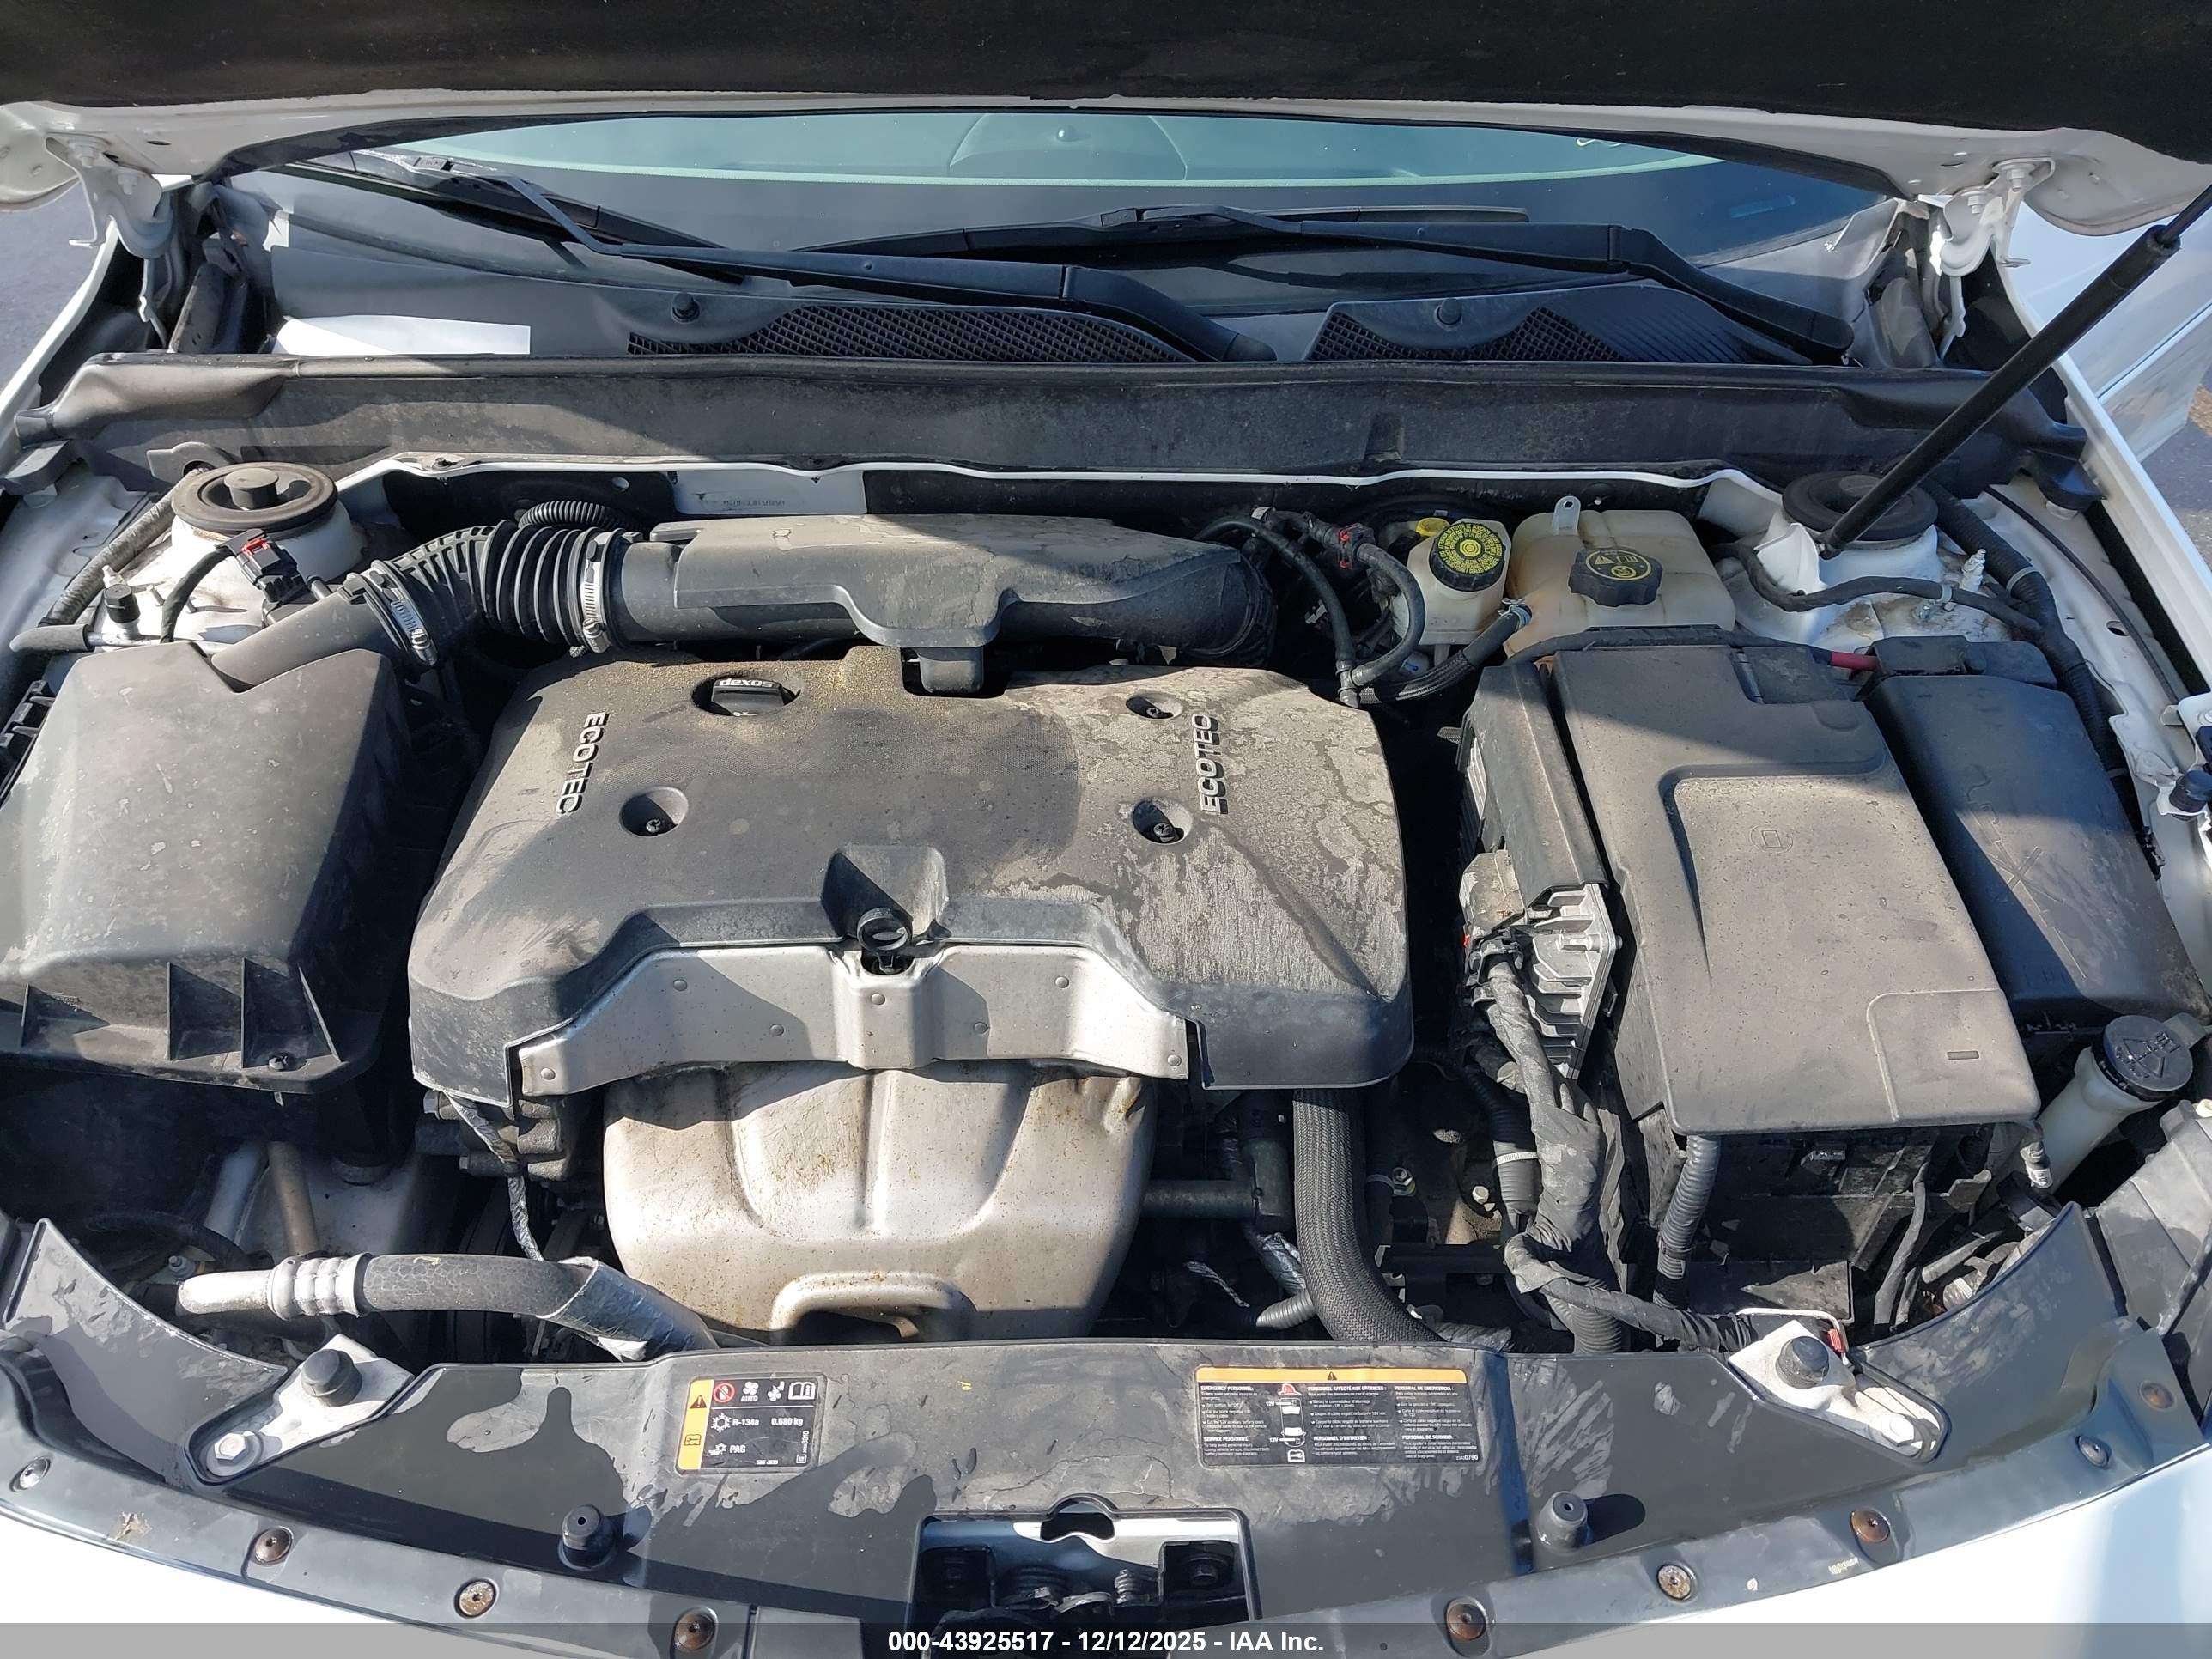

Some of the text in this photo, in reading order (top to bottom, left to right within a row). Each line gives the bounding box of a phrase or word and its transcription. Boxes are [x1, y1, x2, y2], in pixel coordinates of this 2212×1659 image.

[719, 678, 774, 688] dexos
[556, 711, 609, 815] ECOTEC
[1192, 714, 1225, 815] ECOTEC
[732, 1418, 759, 1426] R-134a
[793, 1418, 804, 1427] kg
[729, 1444, 746, 1454] PAG
